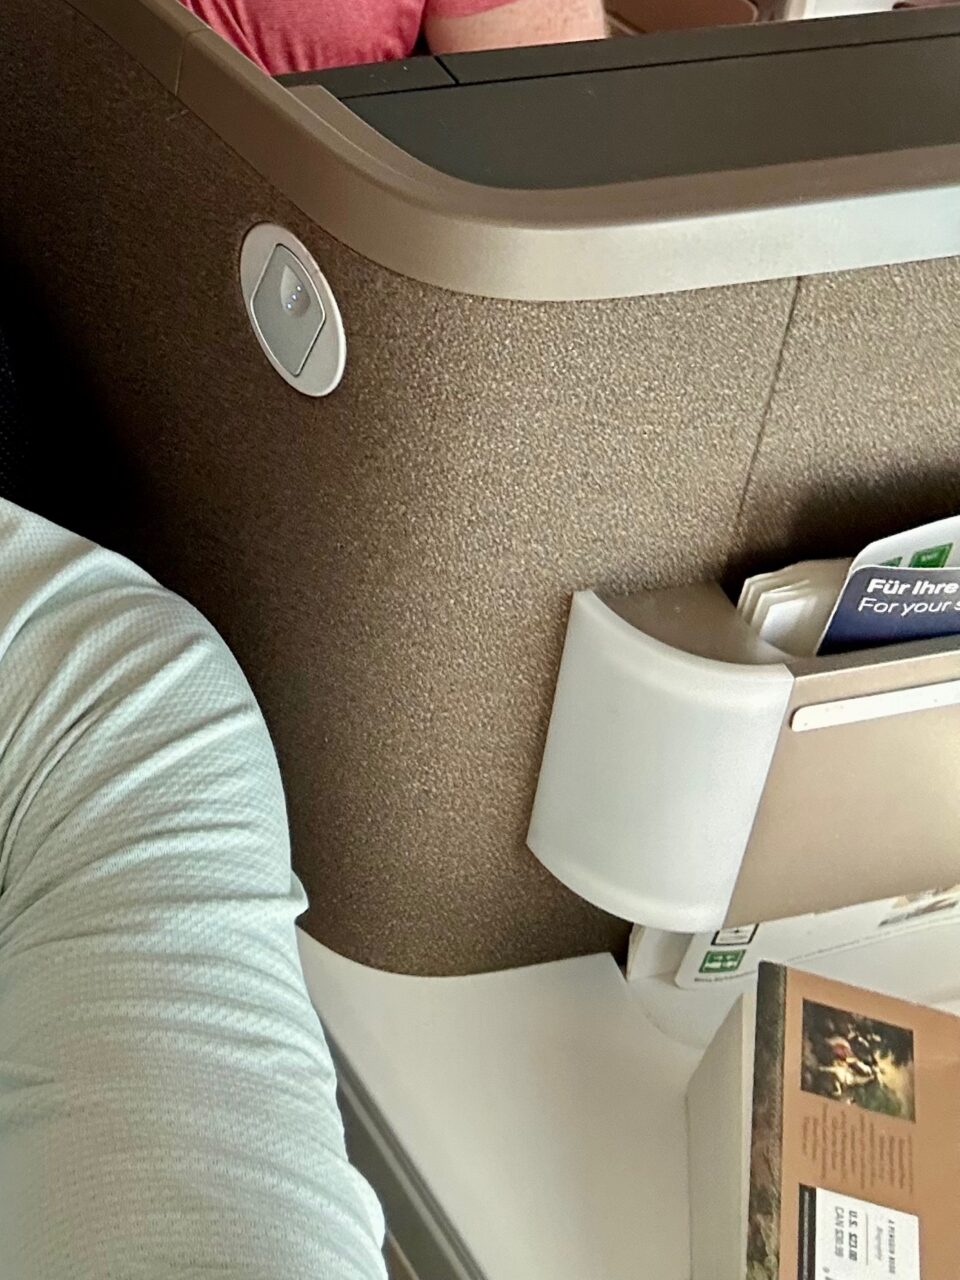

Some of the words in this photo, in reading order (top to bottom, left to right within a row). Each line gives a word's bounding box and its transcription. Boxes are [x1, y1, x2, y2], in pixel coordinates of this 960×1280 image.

[866, 578, 911, 595] Für
[911, 580, 959, 596] Ihre
[858, 597, 899, 613] For
[900, 601, 952, 617] your
[834, 1206, 845, 1228] CAN
